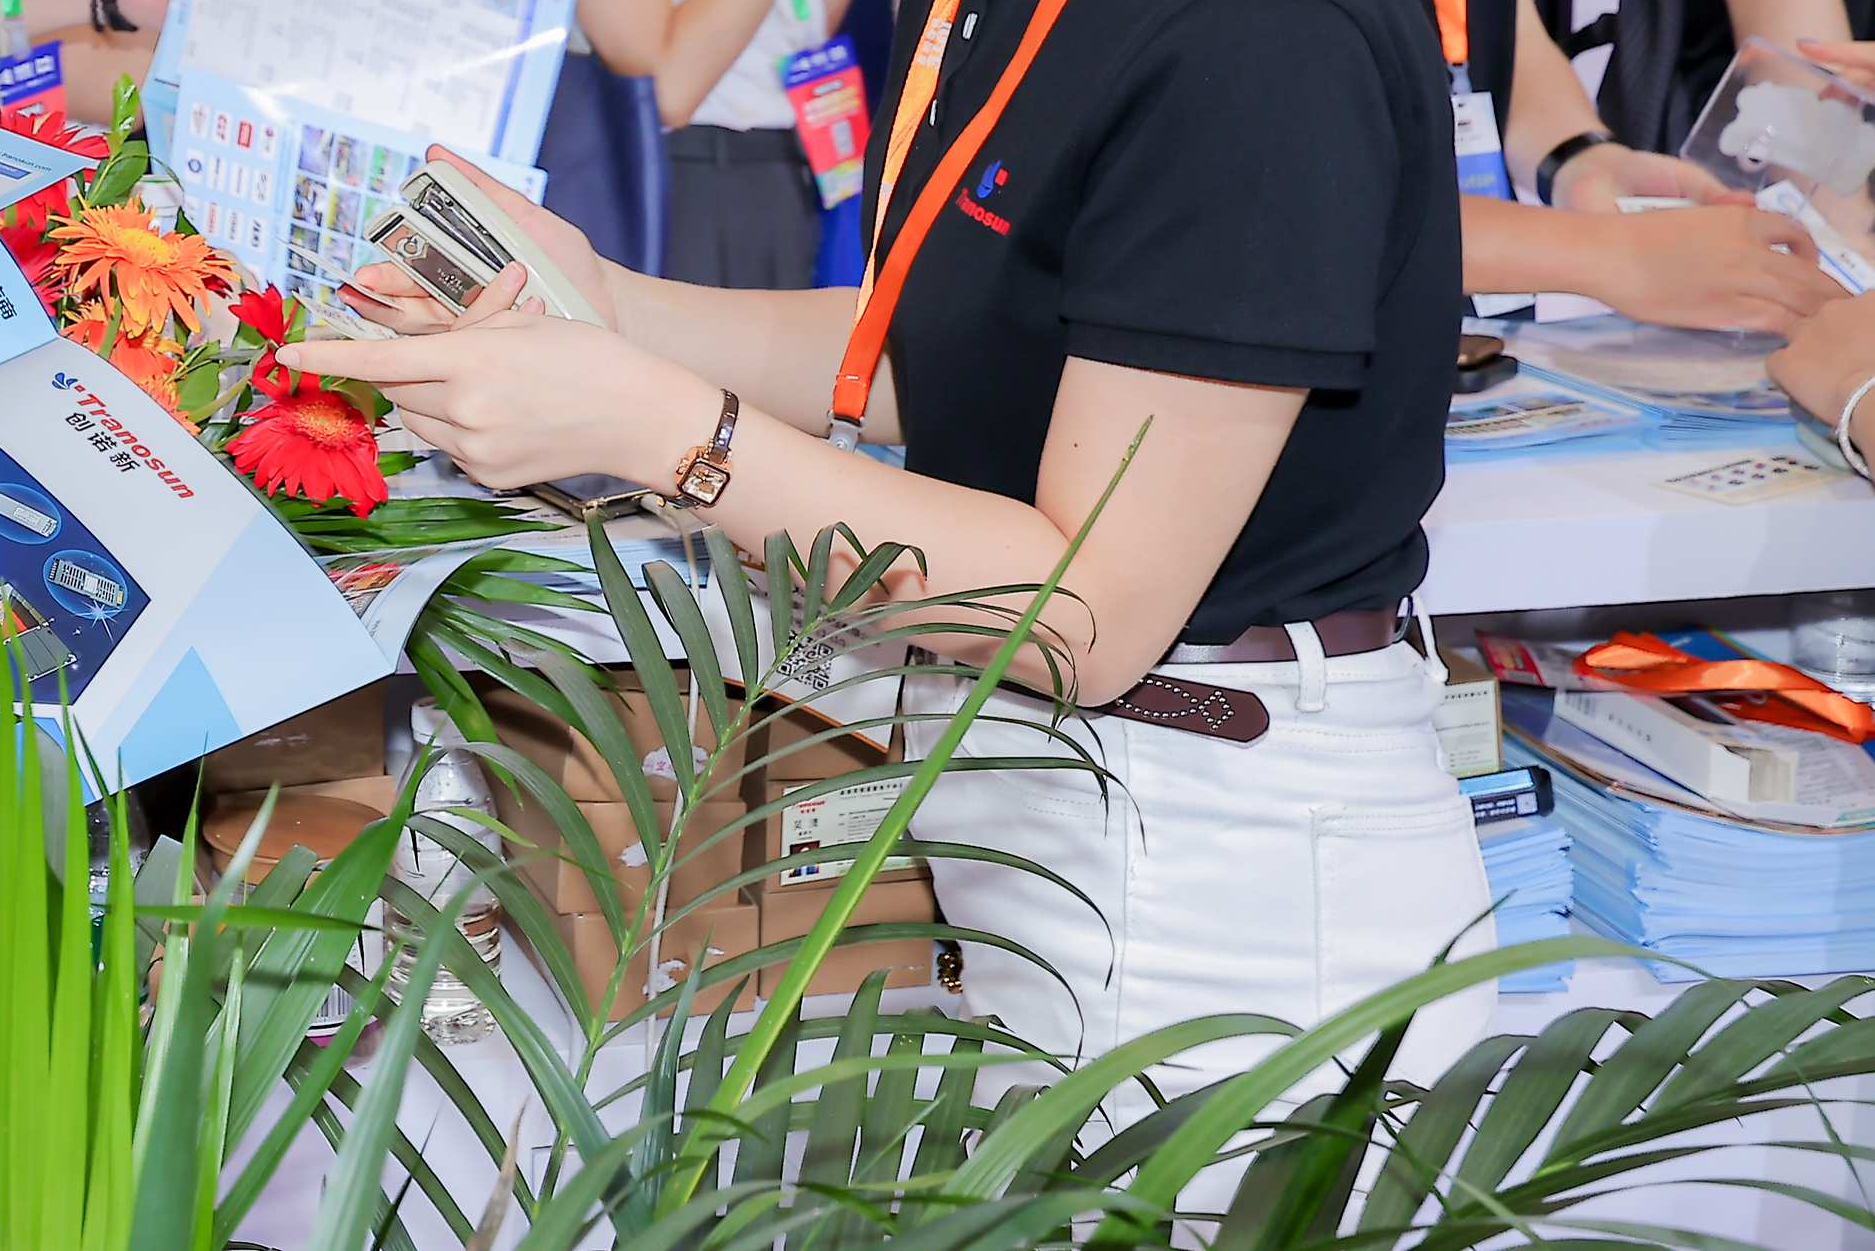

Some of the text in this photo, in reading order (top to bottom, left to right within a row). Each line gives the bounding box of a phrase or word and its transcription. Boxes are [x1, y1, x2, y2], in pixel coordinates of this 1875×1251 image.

[65, 412, 141, 473] 创诺新
[76, 393, 195, 499] Tranosun
